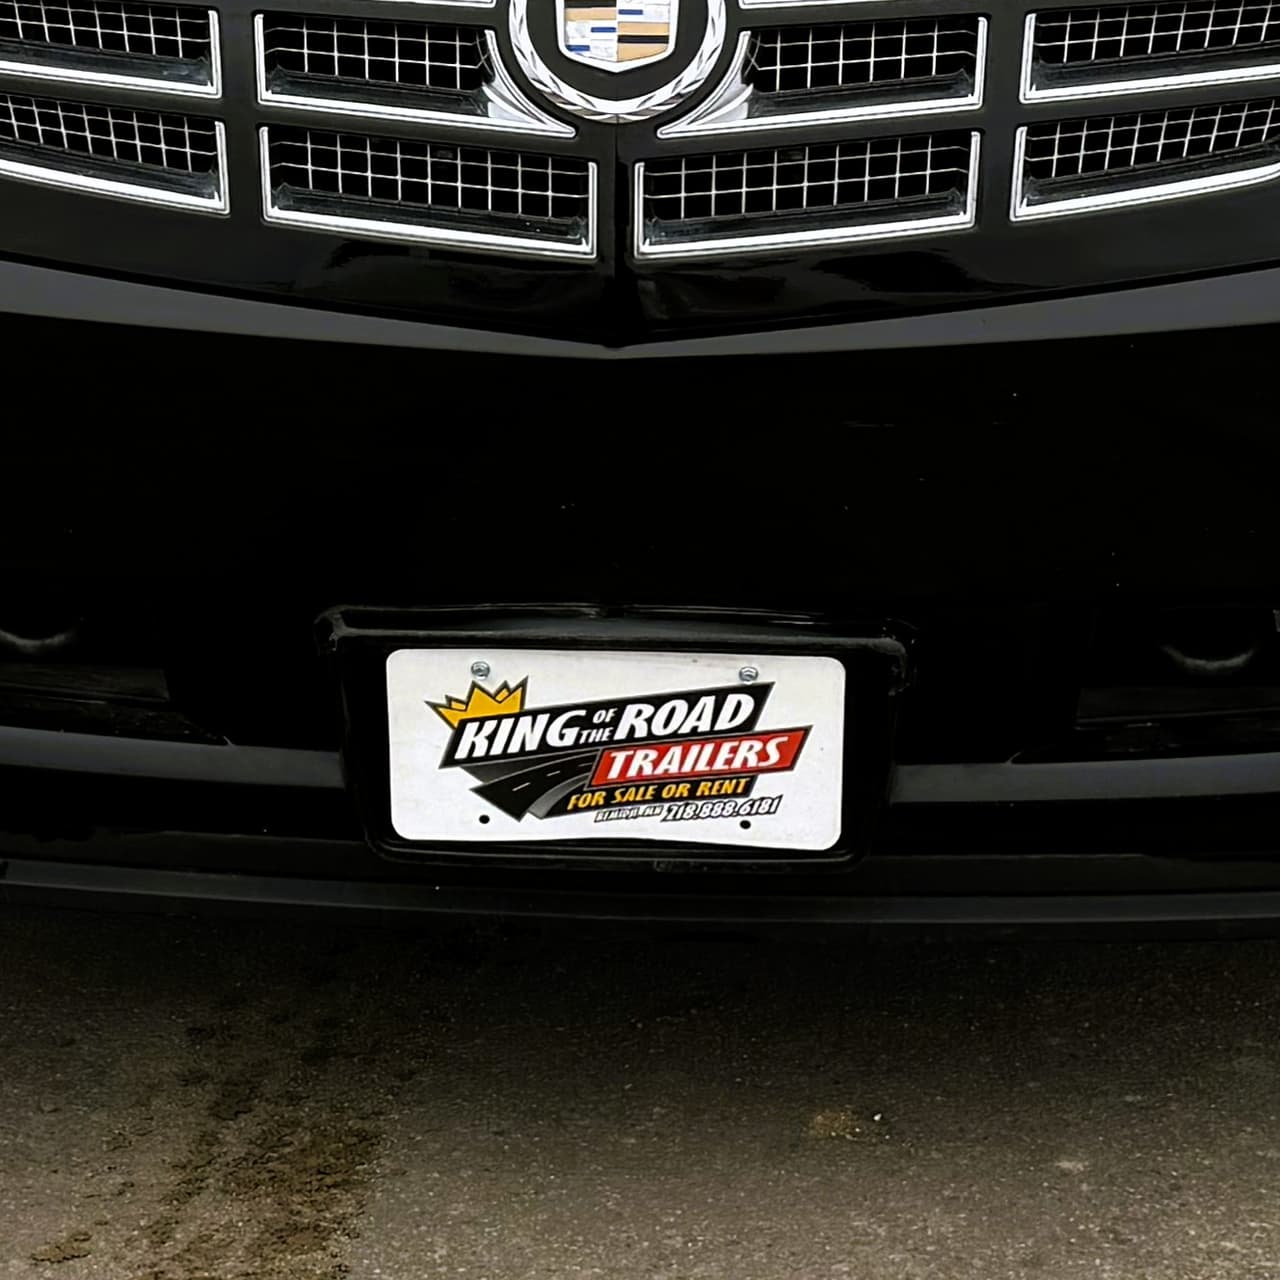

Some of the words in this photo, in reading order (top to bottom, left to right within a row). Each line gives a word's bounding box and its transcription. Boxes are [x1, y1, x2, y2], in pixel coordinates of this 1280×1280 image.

[454, 709, 587, 760] KING
[592, 708, 619, 724] OF
[613, 693, 756, 741] ROAD
[578, 727, 614, 745] THE
[607, 736, 789, 780] TRAILERS
[567, 791, 607, 810] FOR
[611, 785, 658, 803] SALE
[661, 781, 690, 798] OR
[696, 777, 752, 797] RENT
